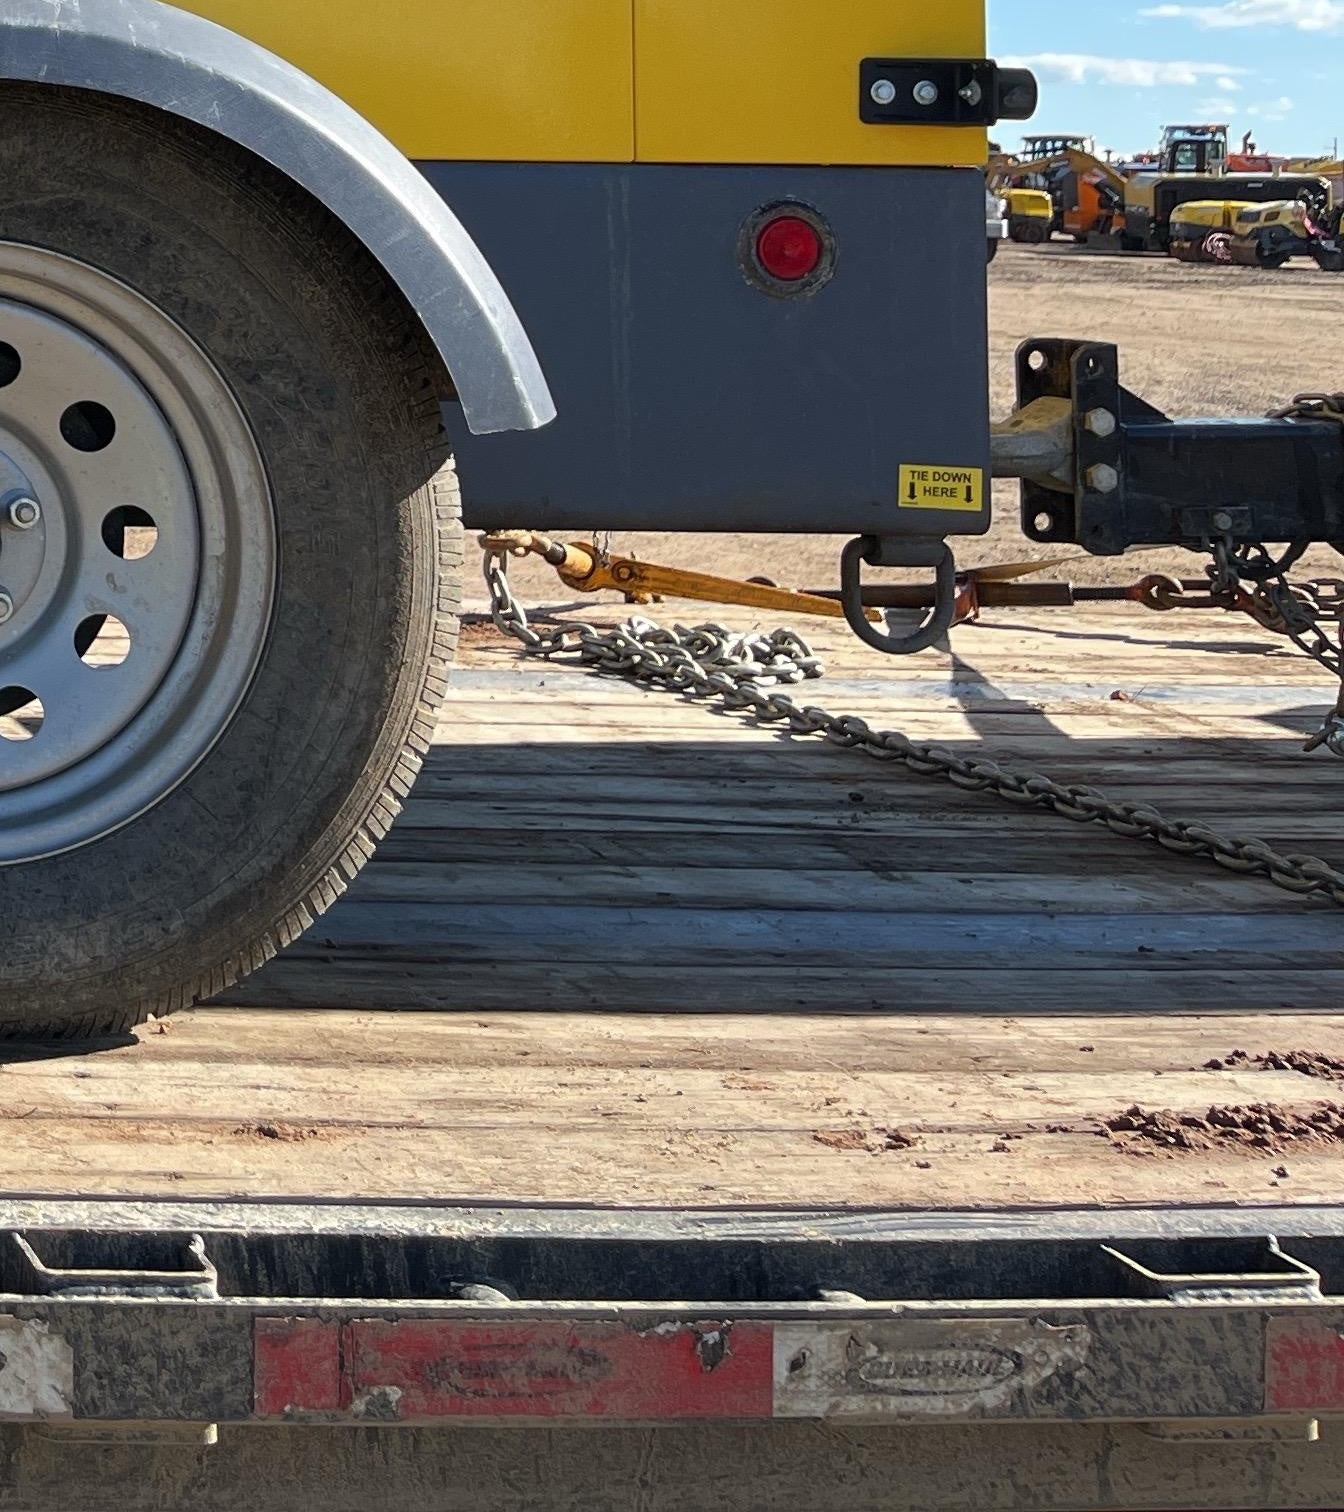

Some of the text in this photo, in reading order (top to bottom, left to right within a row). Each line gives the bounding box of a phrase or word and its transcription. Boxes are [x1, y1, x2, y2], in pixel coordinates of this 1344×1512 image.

[910, 471, 971, 483] TIE DOWN
[923, 486, 957, 497] HERE
